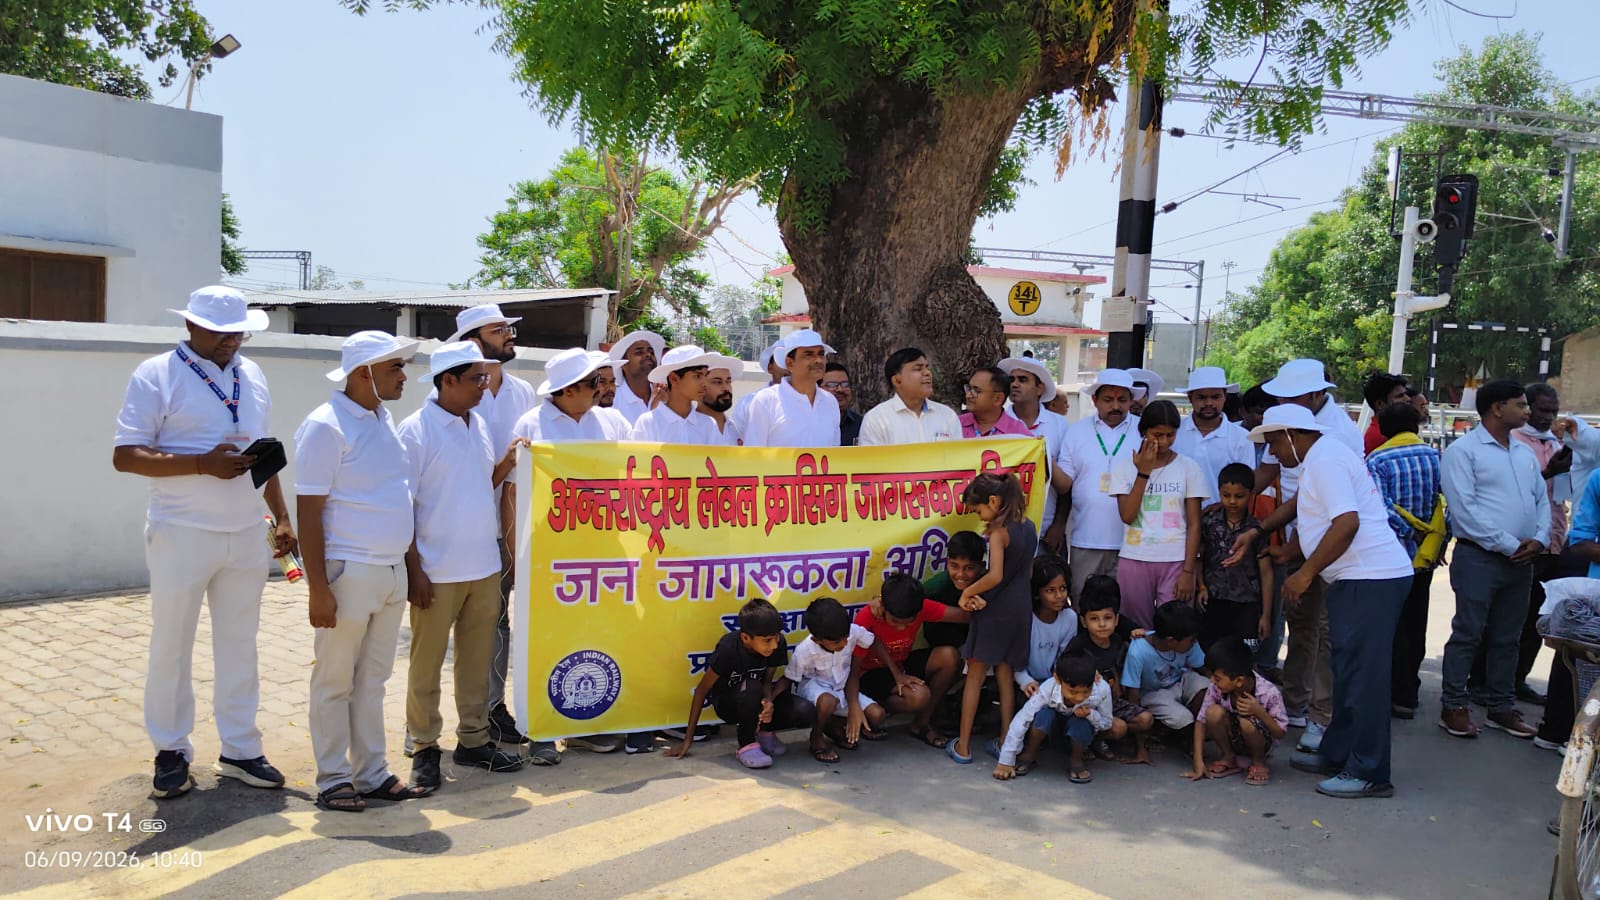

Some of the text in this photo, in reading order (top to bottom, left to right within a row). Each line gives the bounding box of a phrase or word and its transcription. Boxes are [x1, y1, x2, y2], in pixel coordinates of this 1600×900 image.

[1018, 300, 1030, 313] T
[696, 456, 759, 529] लेवल
[763, 453, 848, 536] क्रासिंग
[553, 560, 640, 603] जन
[657, 551, 869, 599] जागरूकता
[582, 651, 611, 664] INDIAN
